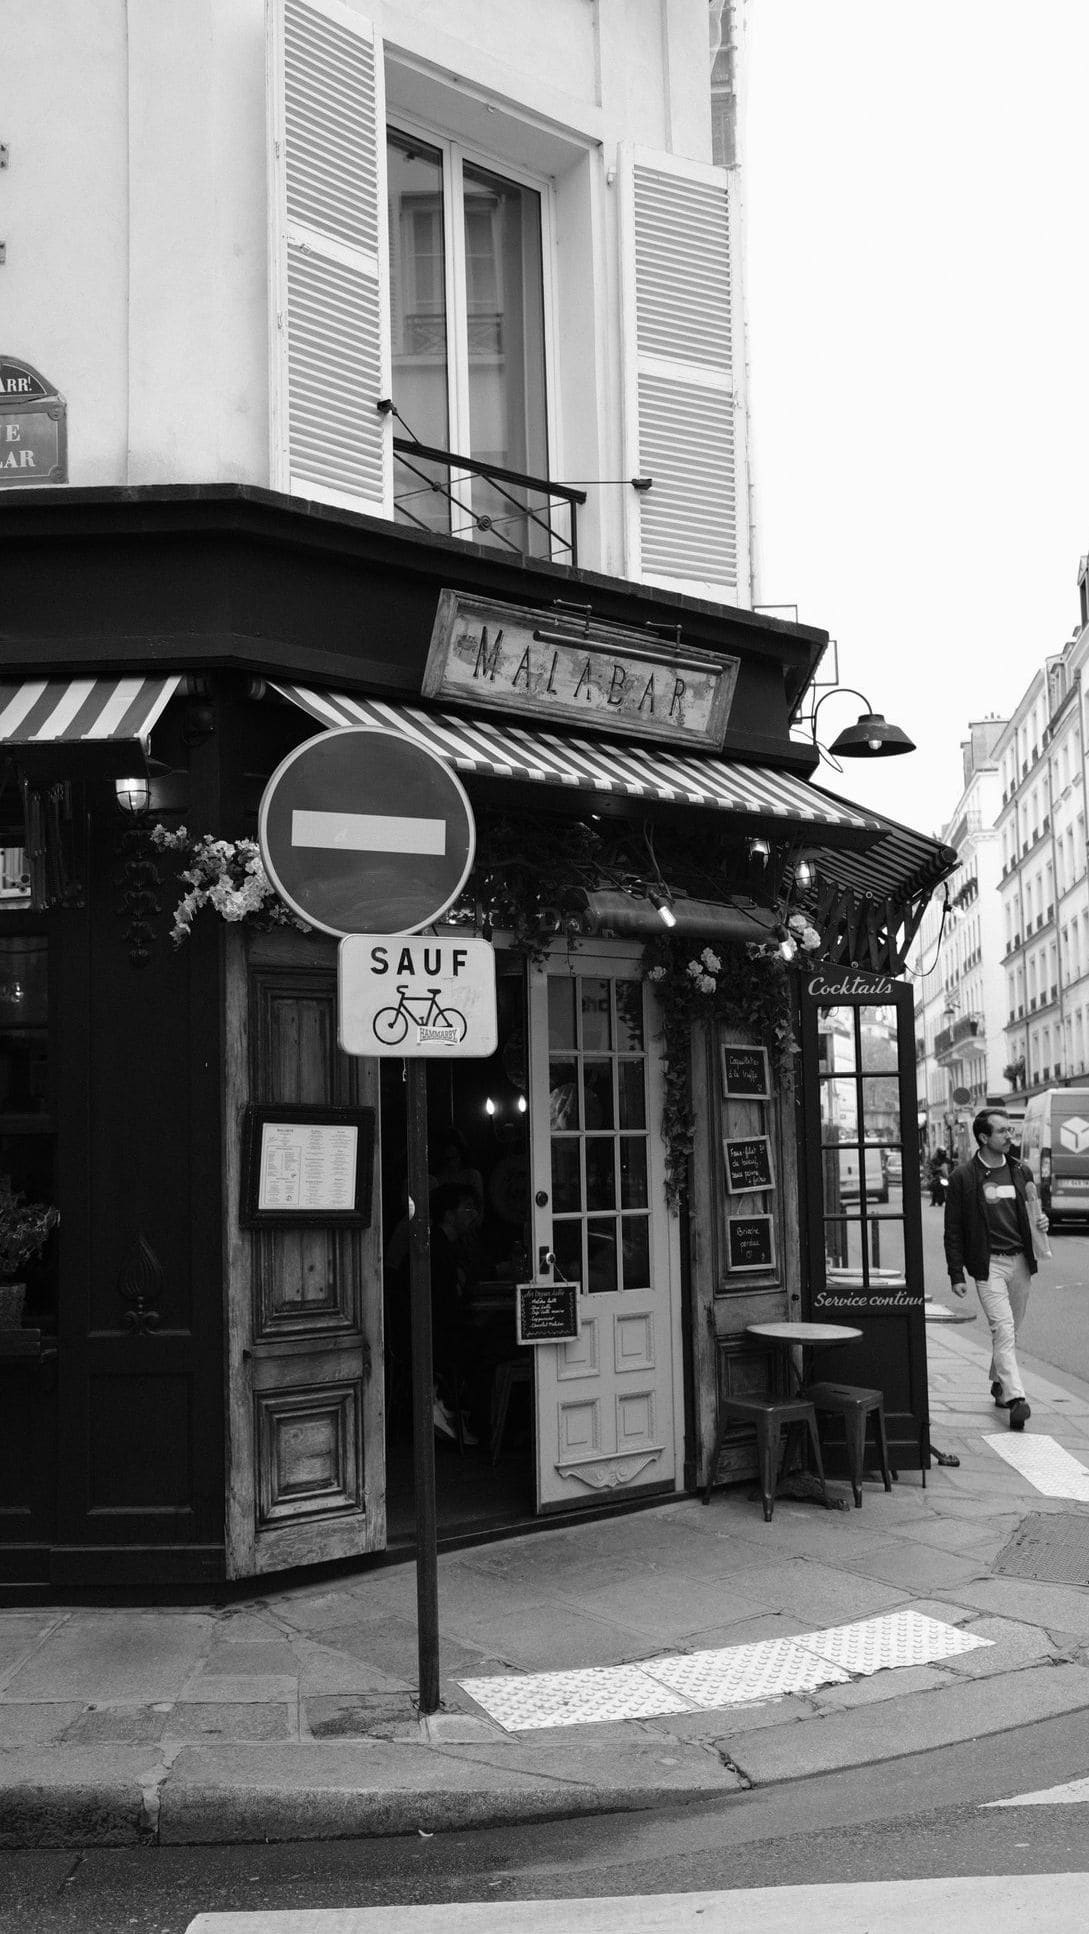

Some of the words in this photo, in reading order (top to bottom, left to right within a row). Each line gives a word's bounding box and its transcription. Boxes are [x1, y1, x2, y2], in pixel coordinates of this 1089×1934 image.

[472, 625, 687, 717] MALABAR
[370, 946, 468, 977] SAUF
[808, 976, 894, 996] Cocktails
[814, 1292, 868, 1307] Service
[868, 1291, 924, 1306] continu
